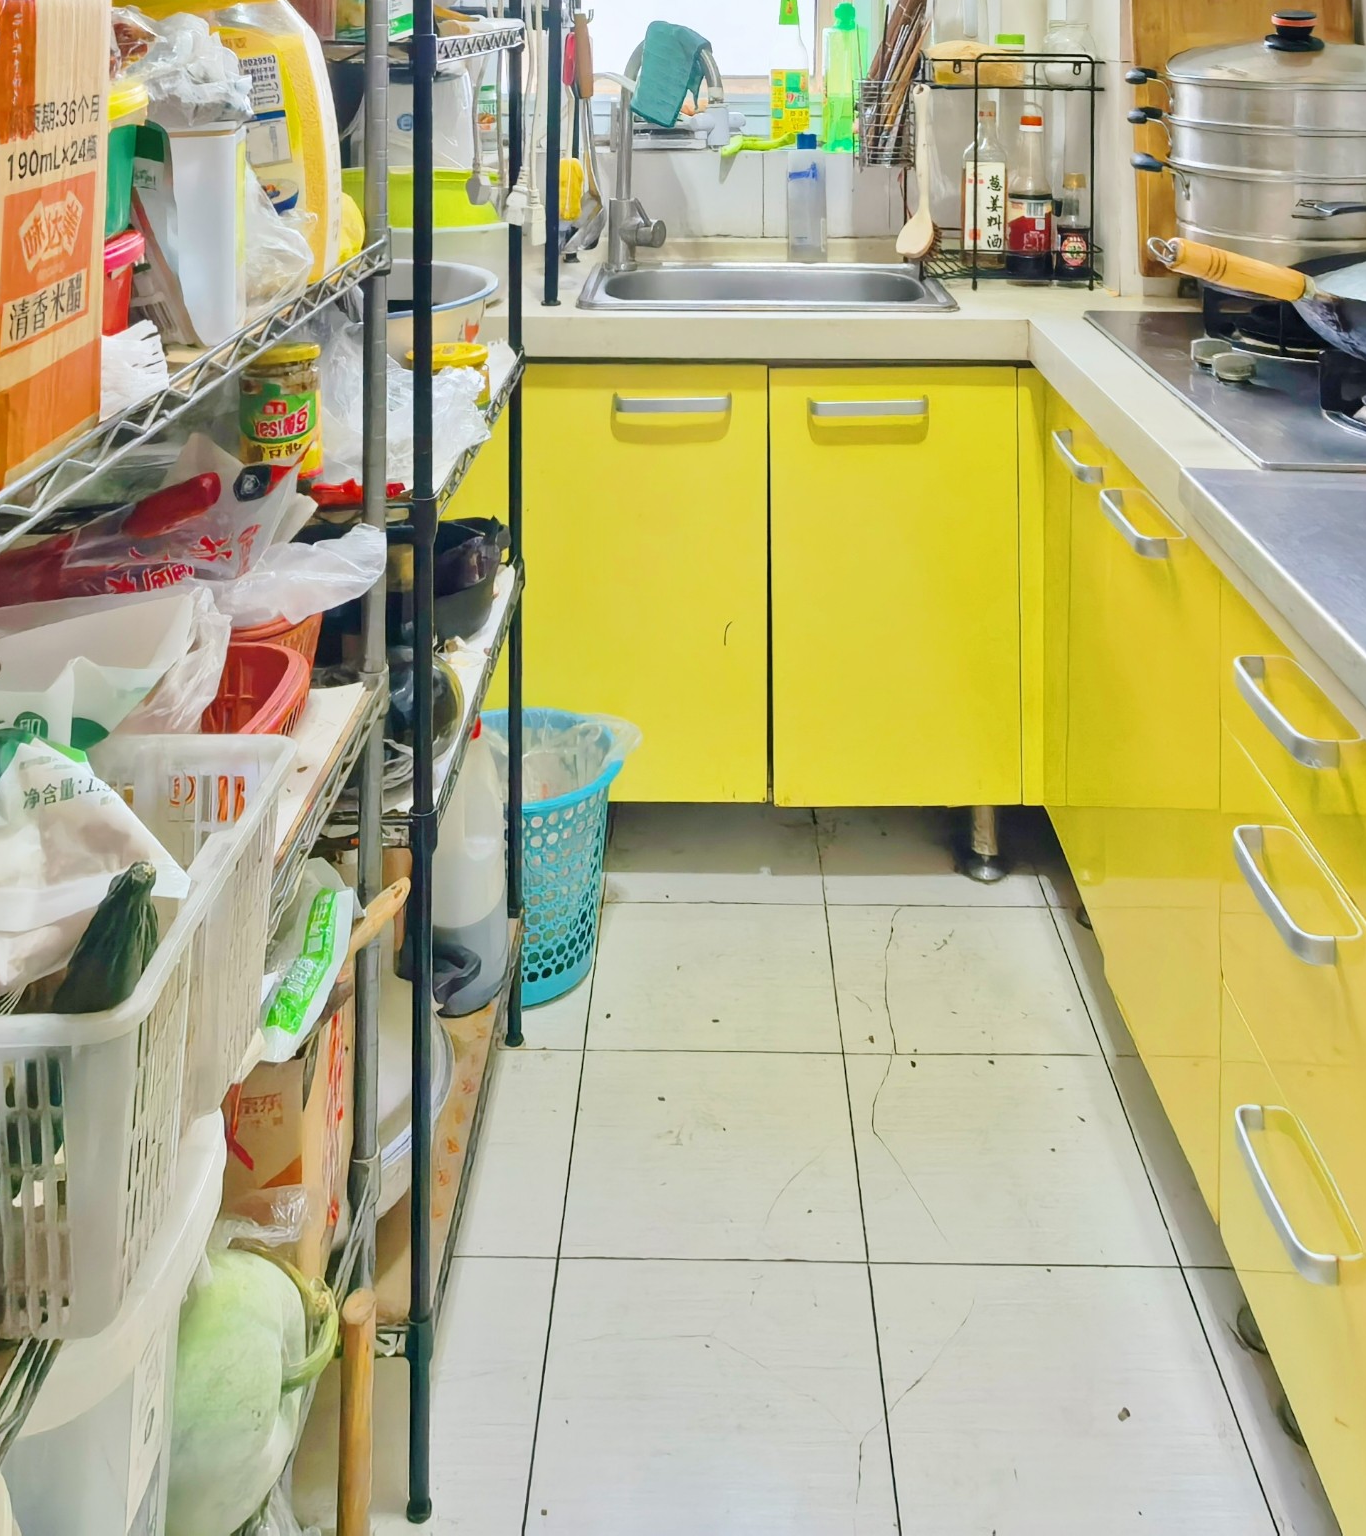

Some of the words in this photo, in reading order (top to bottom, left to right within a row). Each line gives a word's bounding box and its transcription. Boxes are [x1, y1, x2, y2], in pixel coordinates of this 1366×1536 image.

[987, 175, 1002, 248] 葱姜料酒
[9, 272, 82, 342] 清香米醋
